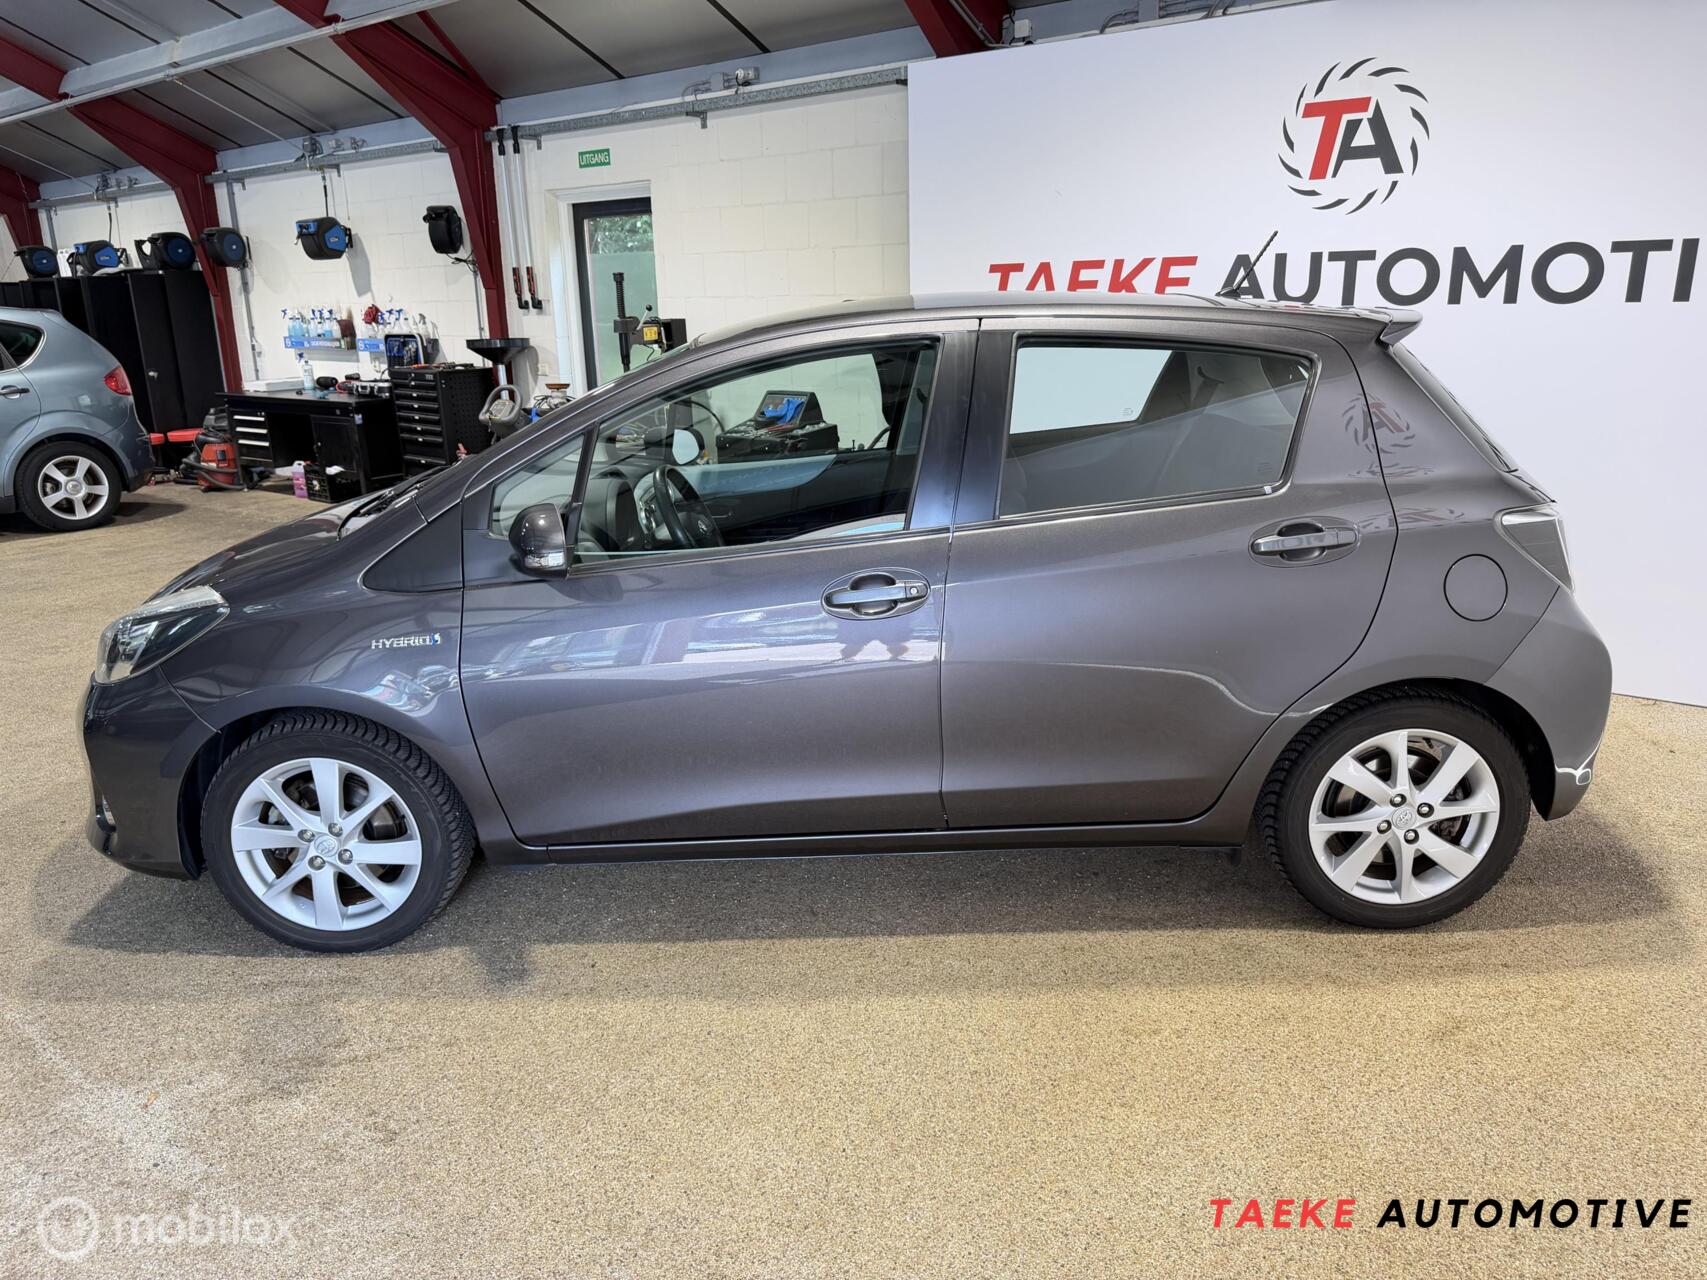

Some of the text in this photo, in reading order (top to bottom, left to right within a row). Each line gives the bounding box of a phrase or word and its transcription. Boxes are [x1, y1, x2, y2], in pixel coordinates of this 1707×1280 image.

[1301, 96, 1404, 181] TA
[579, 152, 609, 166] UITGANG
[988, 256, 1199, 295] TAEKE
[371, 634, 433, 650] HYBRID
